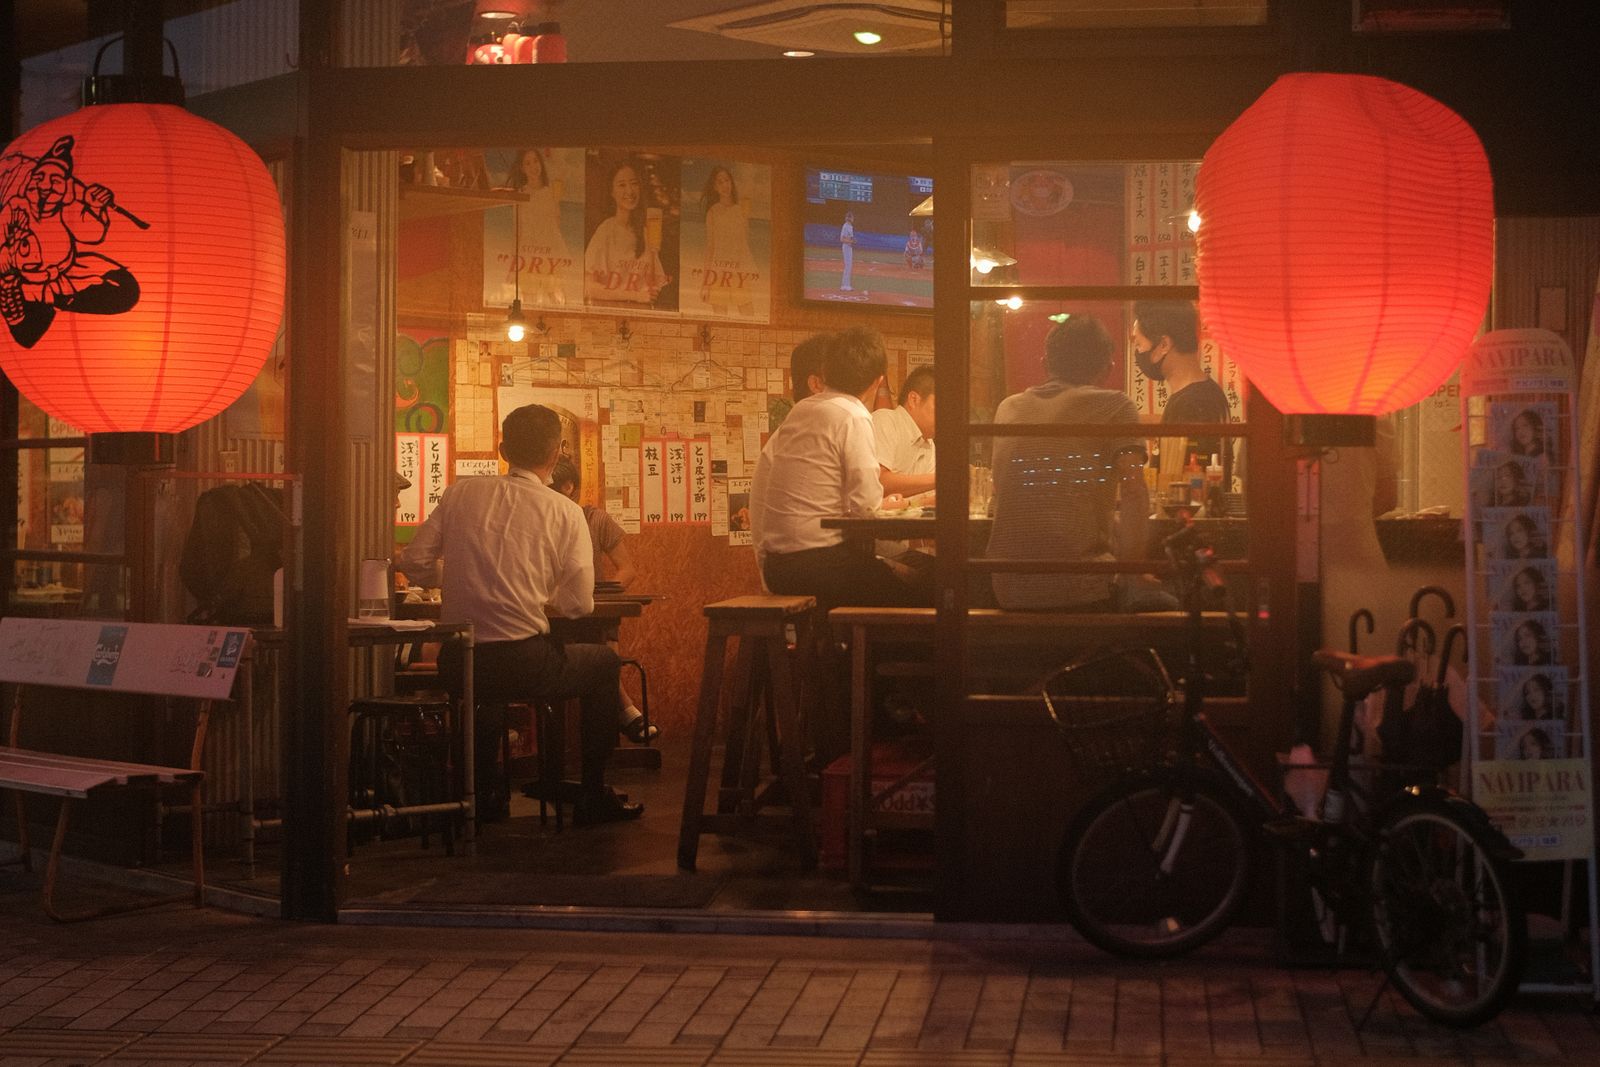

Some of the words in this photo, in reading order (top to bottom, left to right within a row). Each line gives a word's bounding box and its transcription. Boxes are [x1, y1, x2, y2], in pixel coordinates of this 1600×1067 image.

[521, 245, 551, 254] SUPER
[645, 446, 659, 476] 枝豆
[669, 447, 683, 484] 浅漬け
[647, 513, 660, 522] 199
[670, 513, 683, 522] 199
[694, 512, 707, 521] 199
[1480, 769, 1585, 793] NAVIPARA
